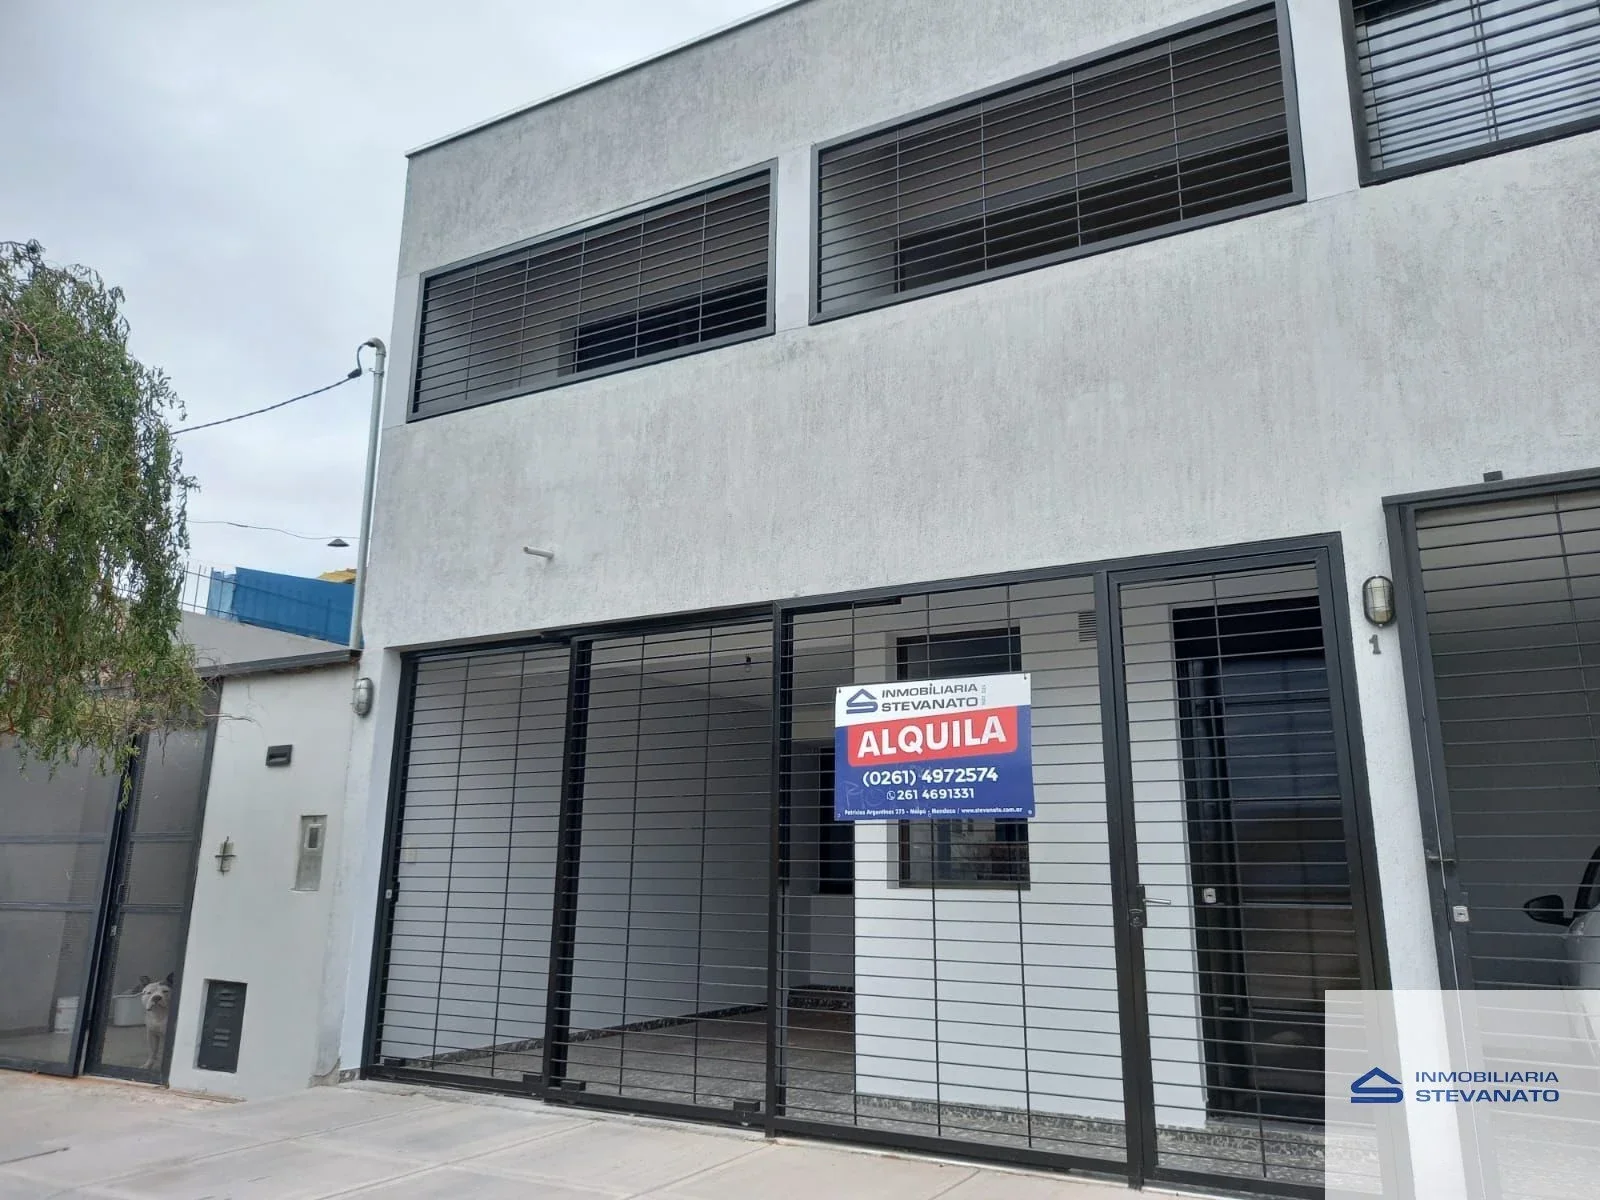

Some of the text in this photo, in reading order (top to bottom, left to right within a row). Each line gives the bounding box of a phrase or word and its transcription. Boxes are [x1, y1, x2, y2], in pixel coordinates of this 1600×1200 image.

[1368, 633, 1382, 655] 1
[881, 683, 978, 699] INMOBILIARIA
[881, 697, 978, 712] STEVANATO
[857, 715, 1007, 759] ALQUILA
[862, 767, 998, 787] (0261) 4972574
[896, 787, 974, 800] 261 4691331
